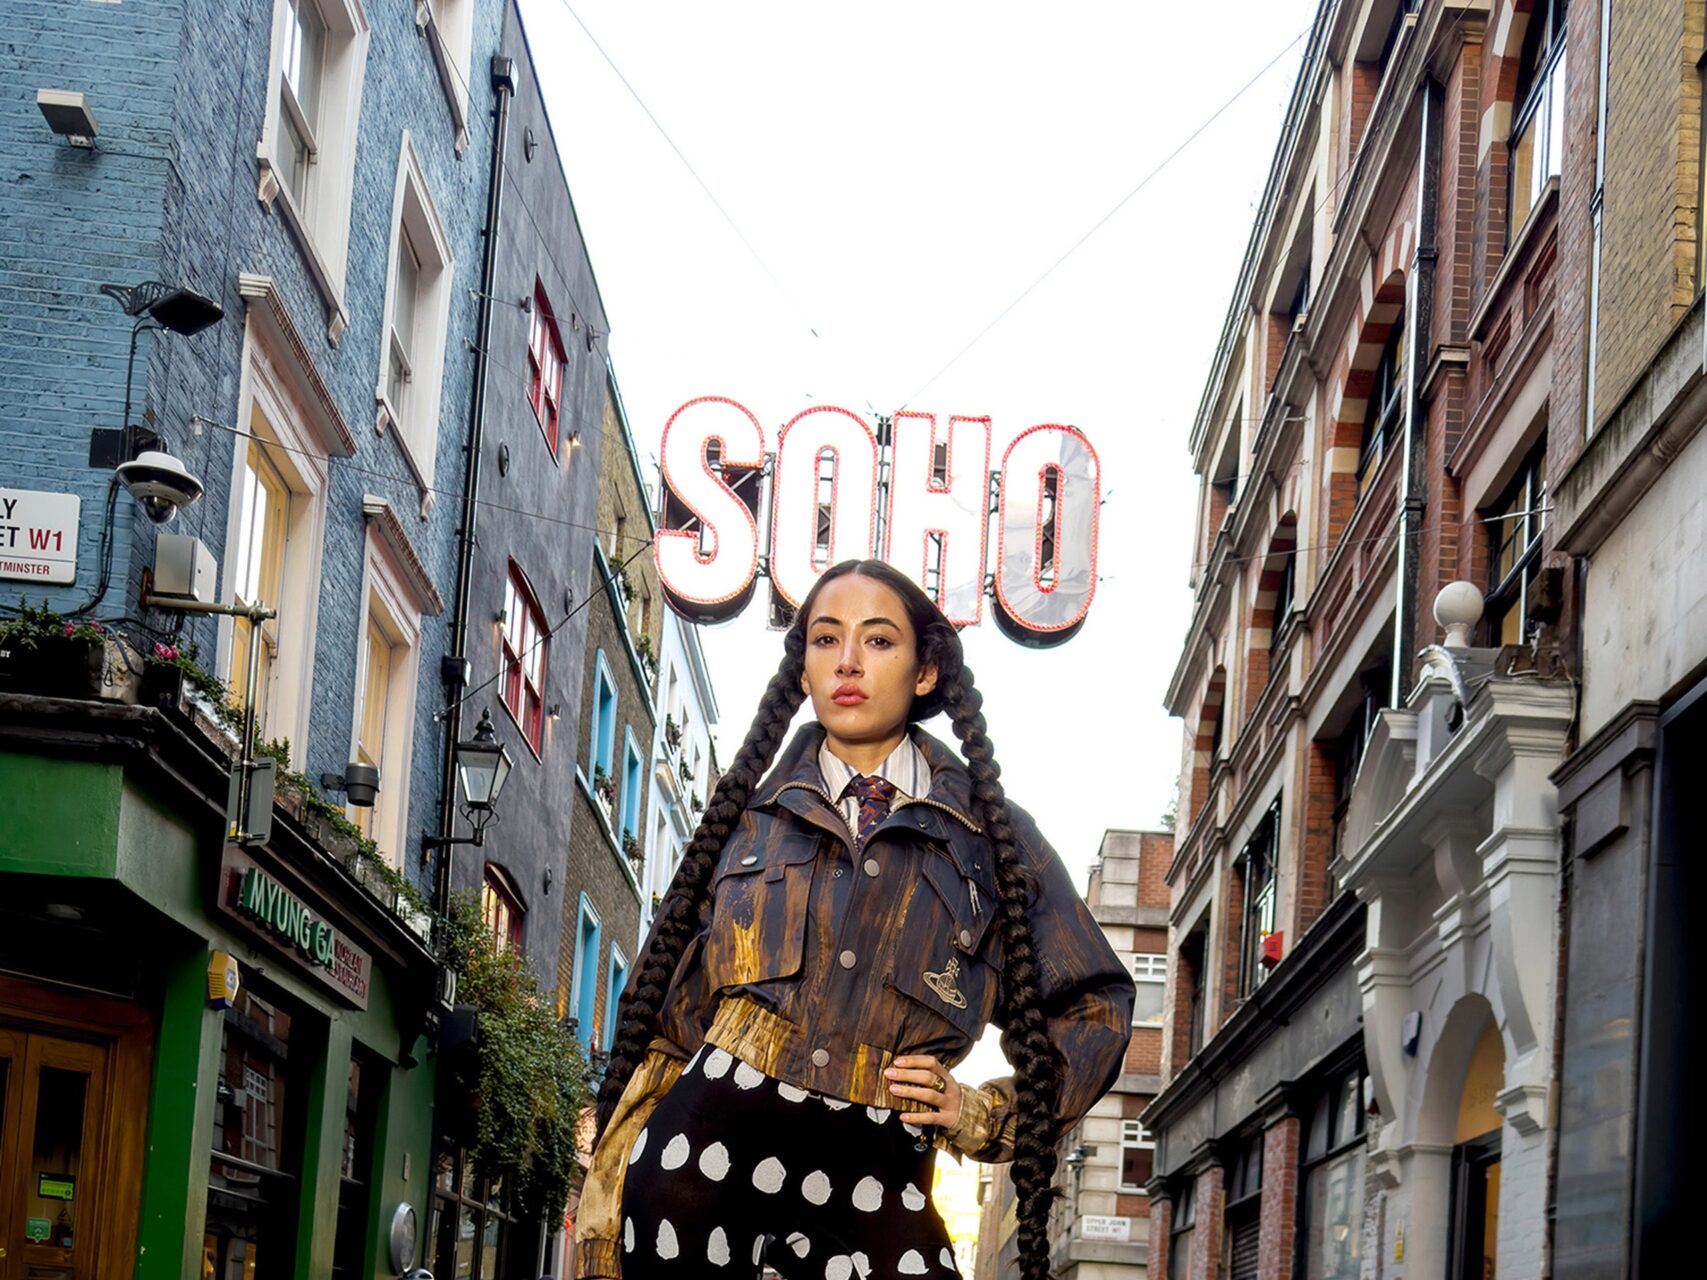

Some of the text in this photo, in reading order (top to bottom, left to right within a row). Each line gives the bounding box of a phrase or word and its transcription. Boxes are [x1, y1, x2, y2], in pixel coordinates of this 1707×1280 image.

[29, 528, 62, 552] W1
[654, 395, 1101, 632] SOHO
[248, 868, 335, 969] MYUNG GA
